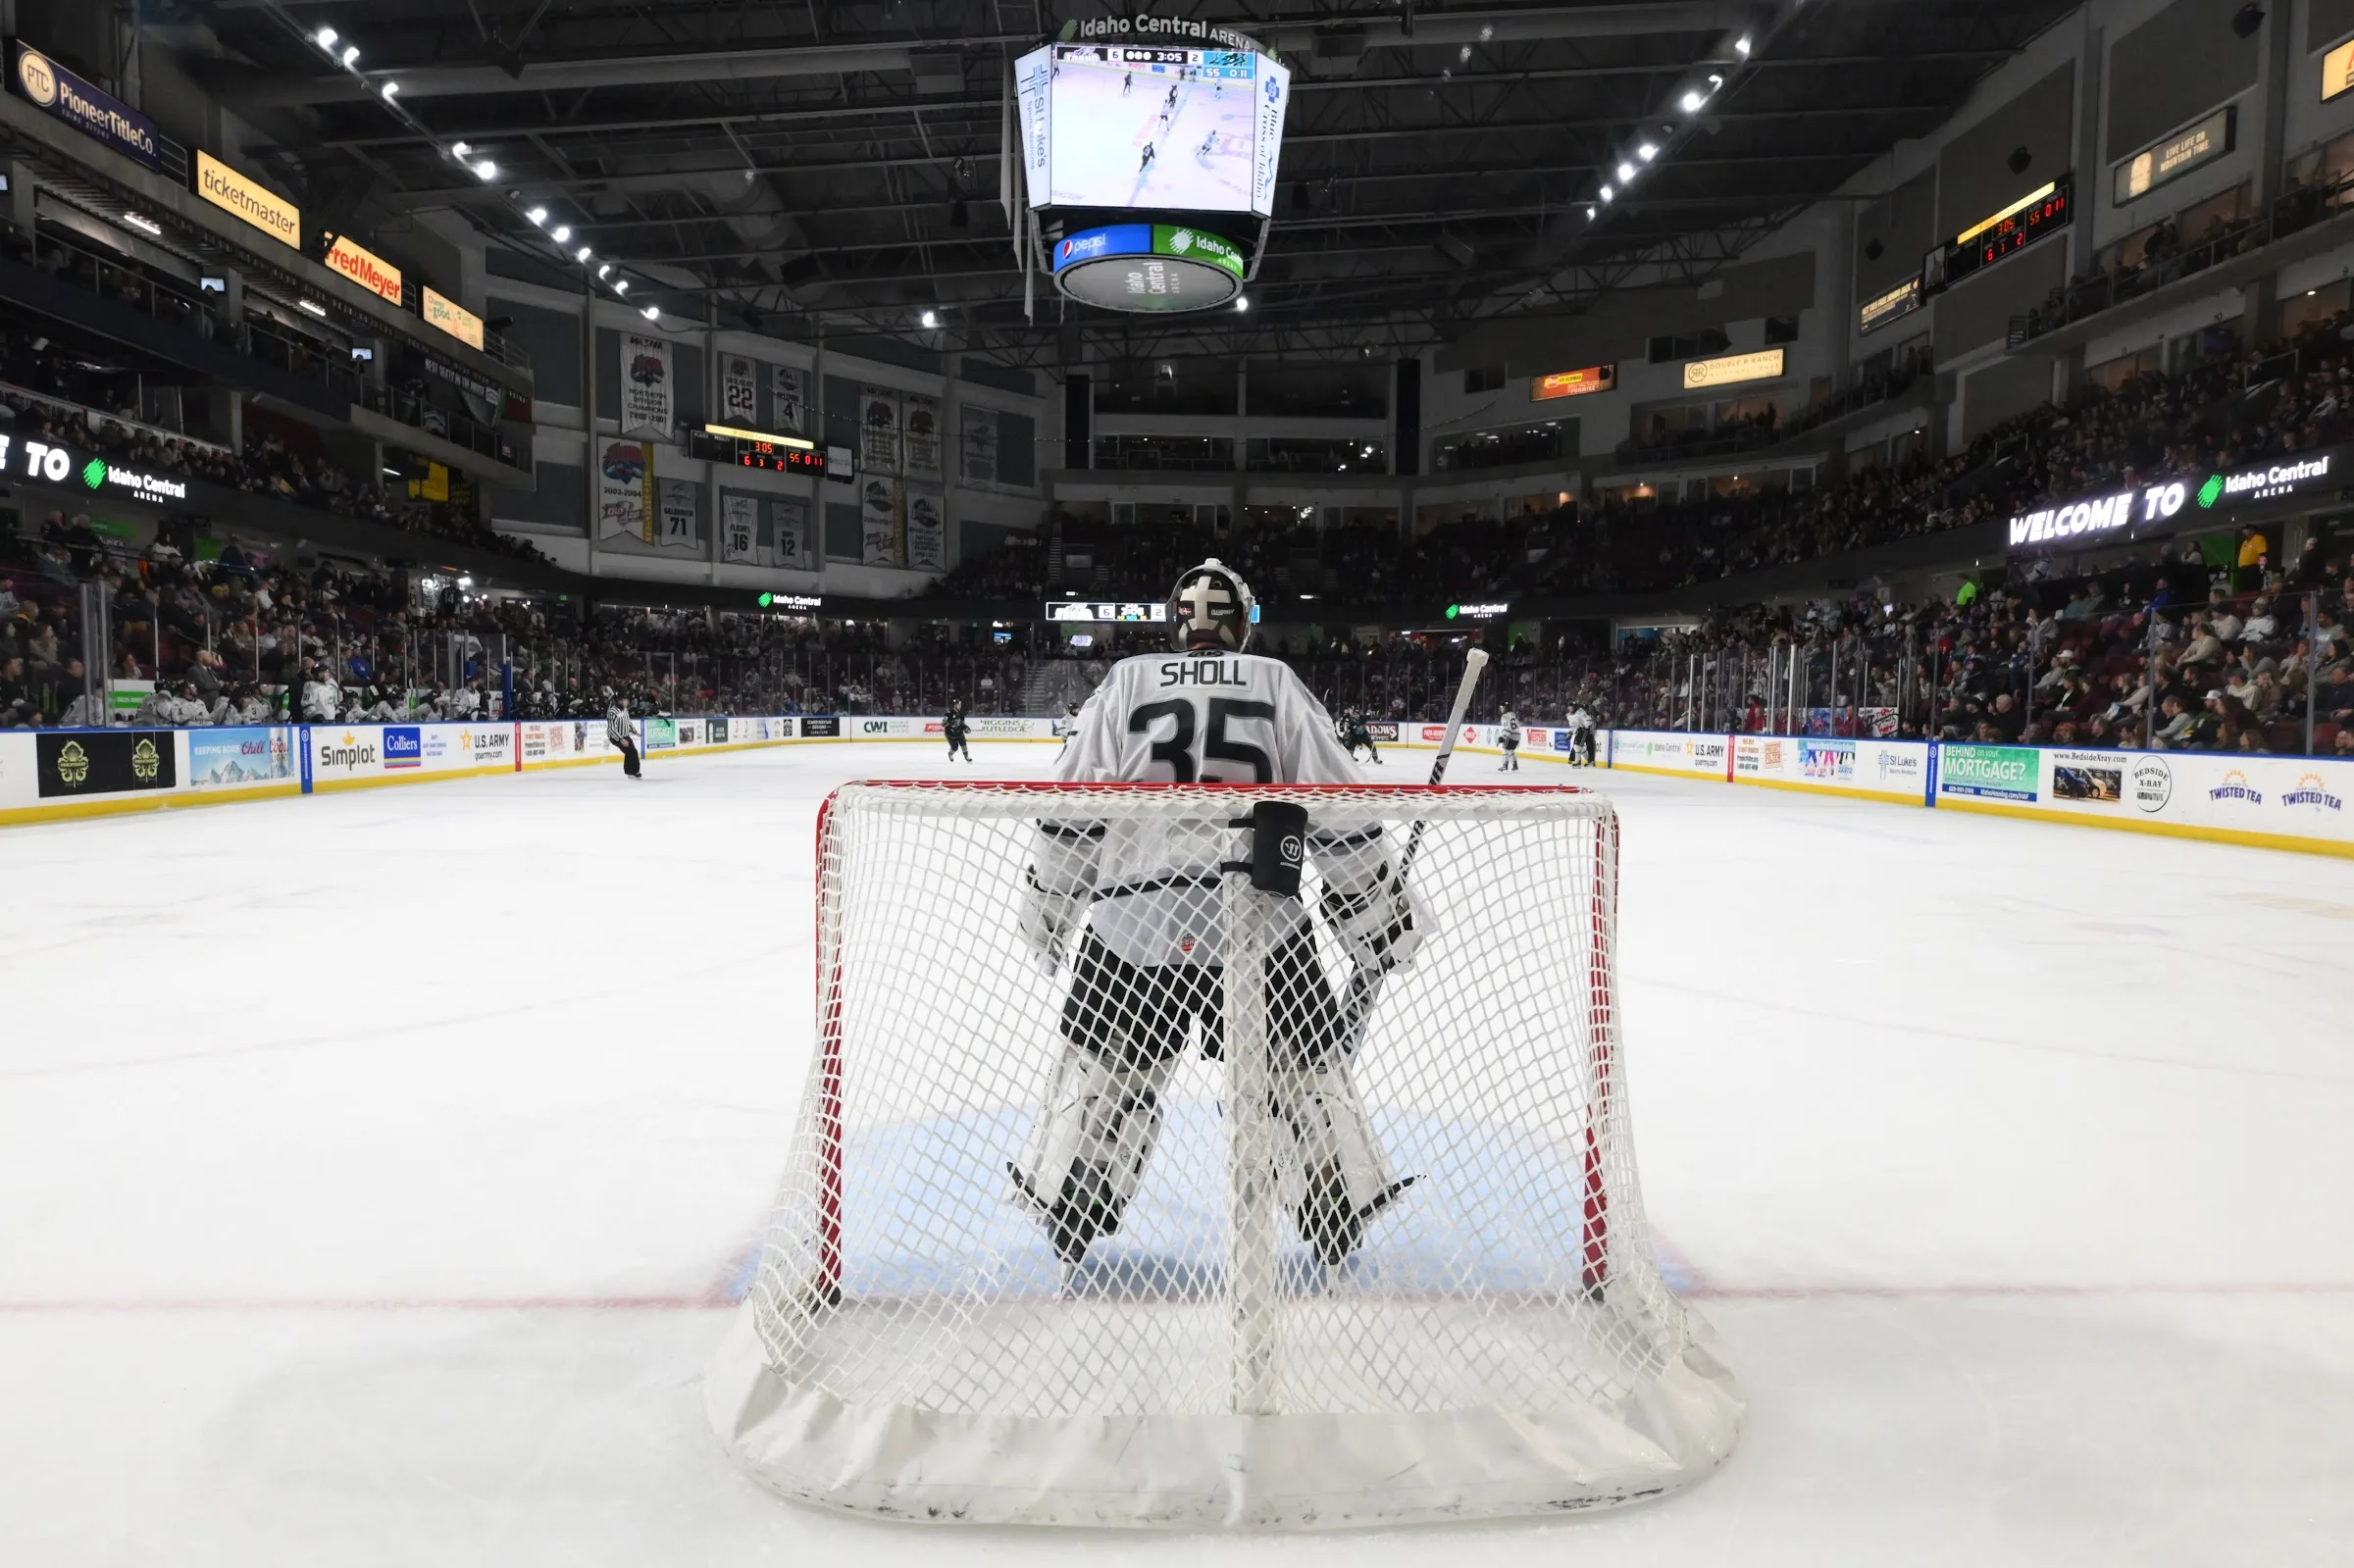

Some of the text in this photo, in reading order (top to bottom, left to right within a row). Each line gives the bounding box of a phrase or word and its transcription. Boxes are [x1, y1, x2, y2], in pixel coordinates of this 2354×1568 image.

[1080, 14, 1251, 50] Idaho Central ARENA
[1156, 52, 1182, 62] 3:05
[27, 65, 49, 92] PTC
[2166, 130, 2206, 159] LIVE LIFE ON
[204, 169, 296, 235] ticketmaster
[2029, 210, 2040, 226] 55
[1074, 233, 1106, 255] pepsi
[1197, 235, 1224, 255] Idaho
[2017, 232, 2023, 245] 2
[1987, 248, 1993, 261] 6
[1125, 272, 1146, 294] Idaho
[1144, 262, 1167, 294] Central
[1710, 360, 1740, 370] DOUBLE
[1751, 354, 1779, 364] RANCH
[729, 384, 753, 410] 22
[784, 402, 793, 420] 4
[26, 441, 71, 481] TO
[743, 455, 750, 466] 6
[759, 458, 764, 467] 3
[776, 462, 783, 471] 2
[790, 453, 800, 464] 55
[108, 466, 186, 499] Idaho Central
[2226, 456, 2329, 493] Idaho Central
[604, 486, 642, 498] 2003-2004
[2254, 484, 2293, 499] ARENA
[2010, 482, 2185, 546] WELCOME TO
[670, 517, 687, 535] 71
[734, 533, 748, 551] 16
[781, 538, 795, 557] 12
[773, 594, 821, 606] Idaho Central
[1155, 608, 1161, 617] 2
[1459, 603, 1508, 614] Idaho Central
[1160, 660, 1247, 686] SHOLL
[864, 721, 888, 733] CWI
[1510, 718, 1516, 730] 6
[194, 745, 222, 756] KEEPING
[241, 739, 266, 755] Chill
[386, 734, 418, 751] Colliers
[475, 733, 510, 749] U.S. ARMY
[1128, 696, 1276, 784] 35
[1654, 742, 1665, 753] Idaho
[1665, 742, 1681, 753] Central
[321, 744, 375, 771] Simplot
[475, 750, 502, 762] goarmy.com
[1695, 744, 1725, 757] U.S. ARMY
[1946, 745, 1975, 758] BEHIND
[2054, 752, 2127, 764] www.BedsideXray.com
[1695, 758, 1717, 768] goarmy.com
[1897, 756, 1918, 767] Luke's
[1944, 757, 2026, 782] MORTGAGE?
[2133, 767, 2170, 782] BEDSIDE
[2139, 780, 2163, 788] X-RAY
[2209, 786, 2262, 805] TWISTED TEA
[2281, 791, 2342, 811] TWISTED TEA
